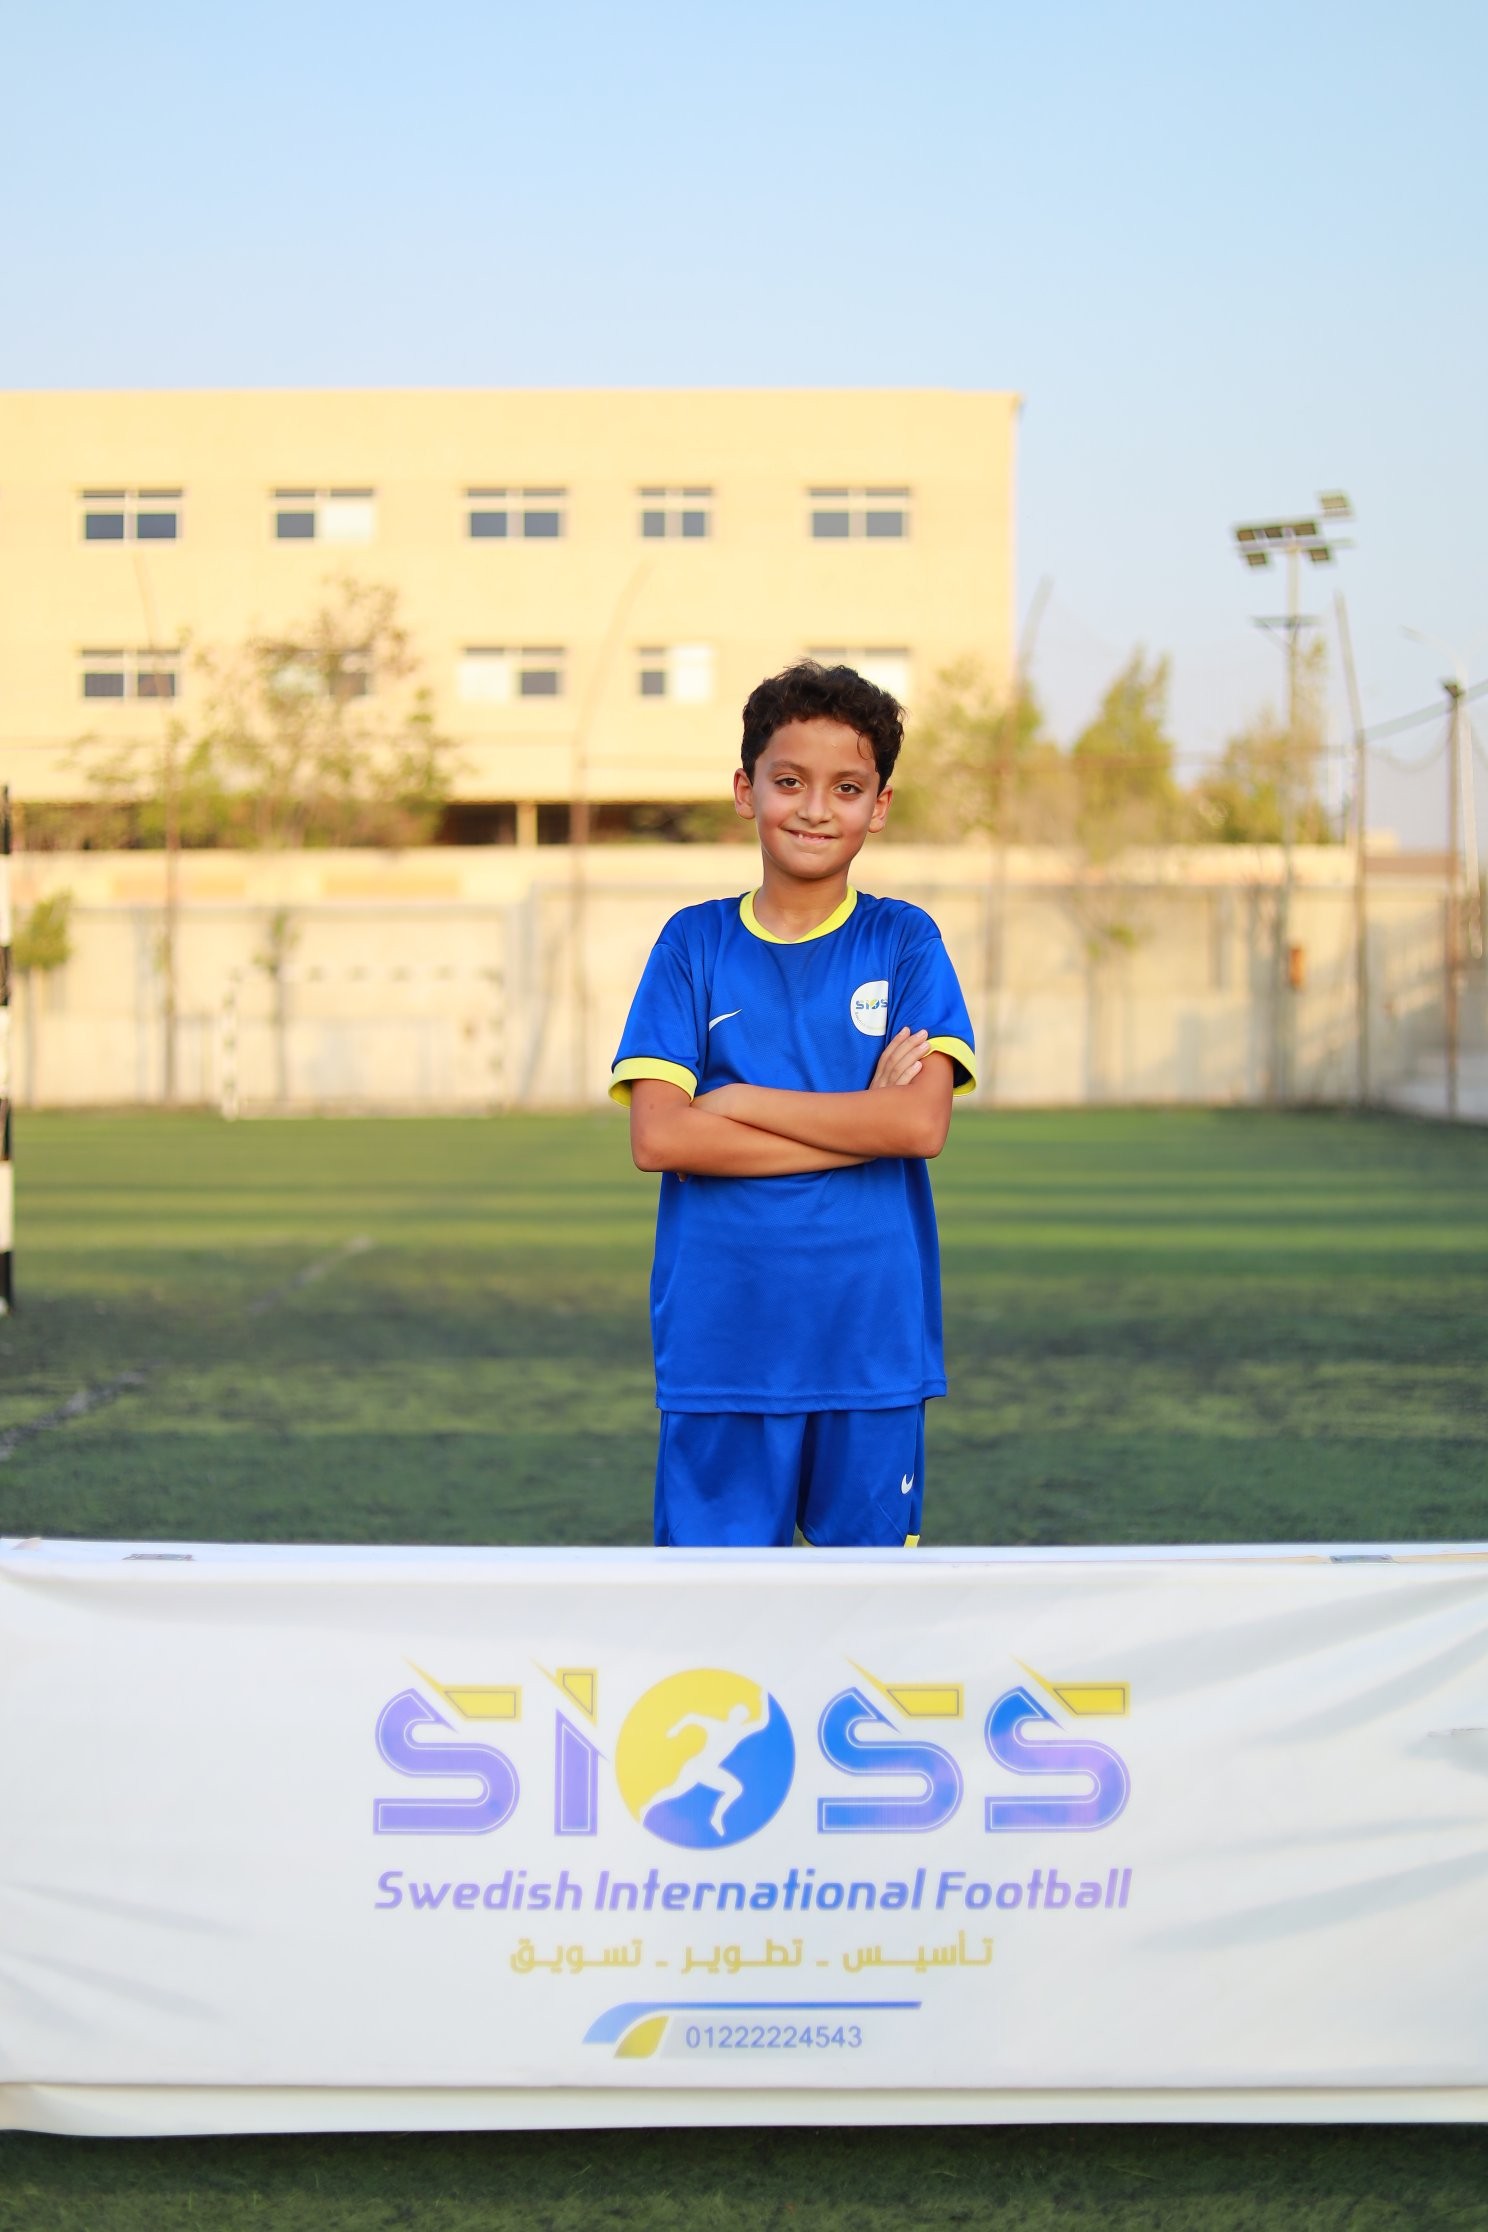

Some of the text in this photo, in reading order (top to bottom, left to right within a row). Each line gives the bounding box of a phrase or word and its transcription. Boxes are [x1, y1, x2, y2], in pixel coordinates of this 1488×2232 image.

[373, 1662, 1132, 1852] SIOSS
[375, 1866, 1133, 1912] Swedish International Football
[509, 1938, 643, 1974] تسويق
[681, 1938, 804, 1975] تطوير
[842, 1930, 994, 1974] تأسيس
[685, 2024, 863, 2049] 01222224543
